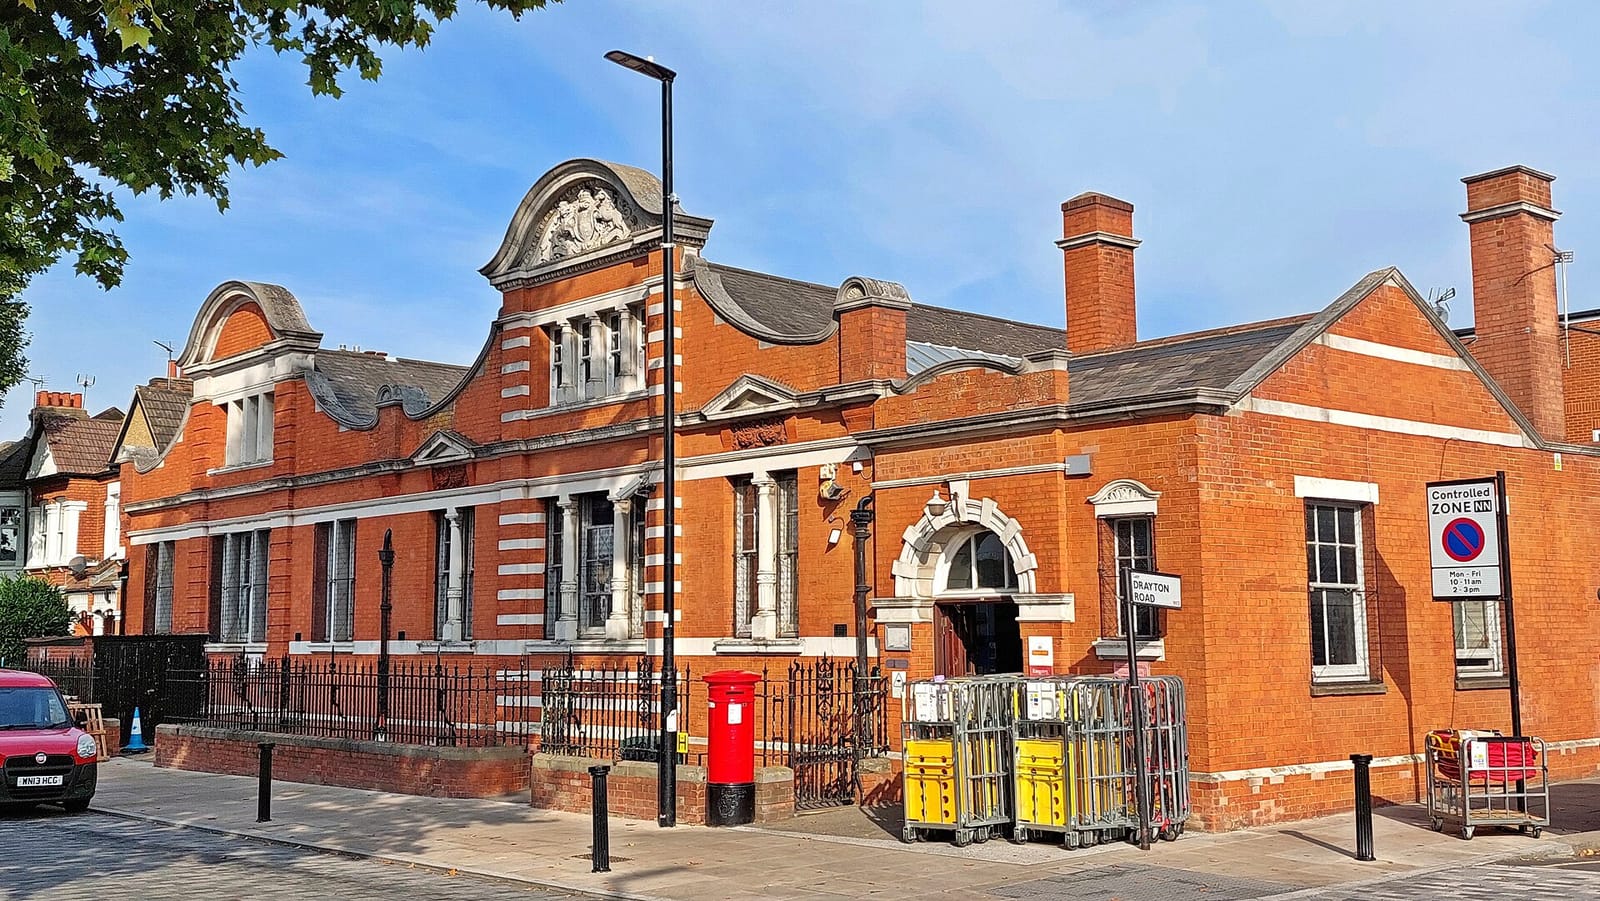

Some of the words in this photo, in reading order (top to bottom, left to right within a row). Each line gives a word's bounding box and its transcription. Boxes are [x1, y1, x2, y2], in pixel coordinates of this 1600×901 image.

[1432, 488, 1490, 500] Controlled
[1432, 502, 1471, 514] ZONE
[1474, 501, 1492, 512] NN
[1133, 580, 1170, 593] DRAYTON
[1134, 592, 1156, 603] ROAD
[678, 735, 687, 751] H
[42, 776, 58, 785] HCG
